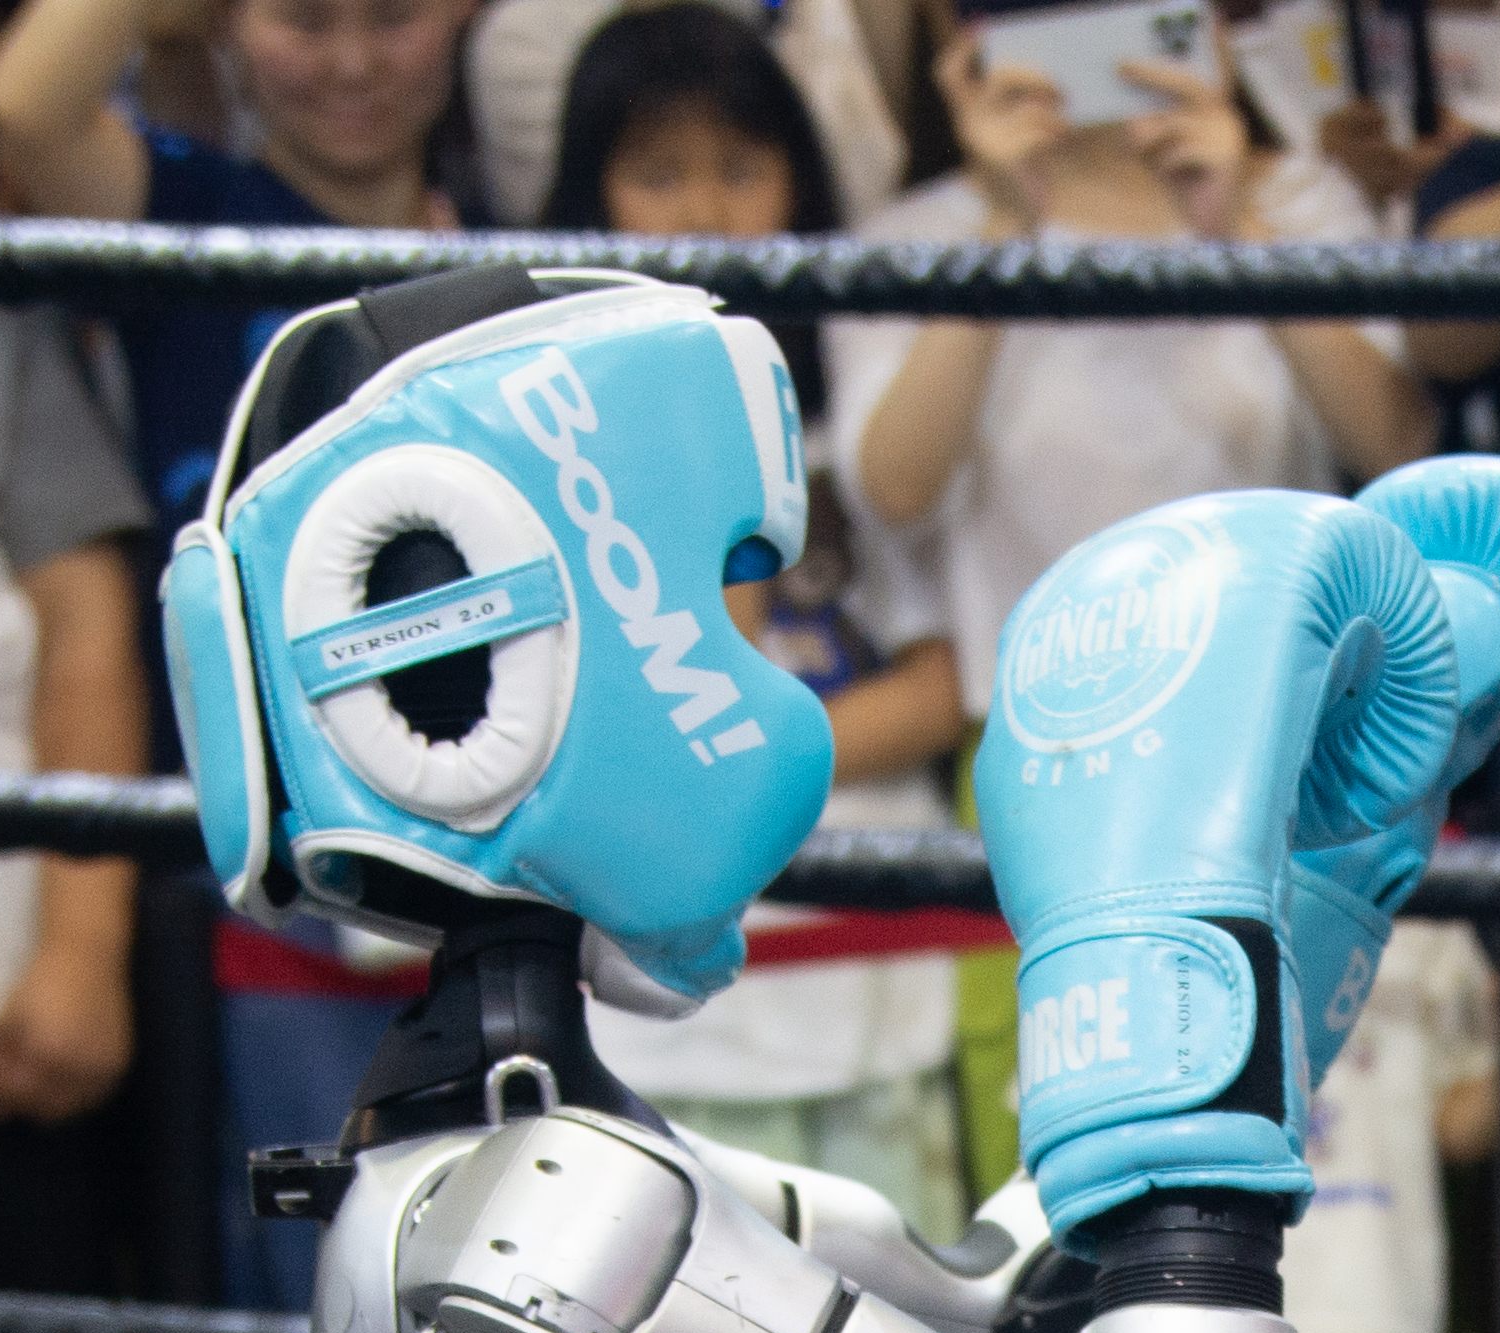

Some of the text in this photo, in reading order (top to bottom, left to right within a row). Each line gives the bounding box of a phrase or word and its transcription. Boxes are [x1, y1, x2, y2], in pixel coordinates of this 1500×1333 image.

[329, 602, 496, 662] VERSION 2.0
[1177, 954, 1191, 1075] VERSION 2.0
